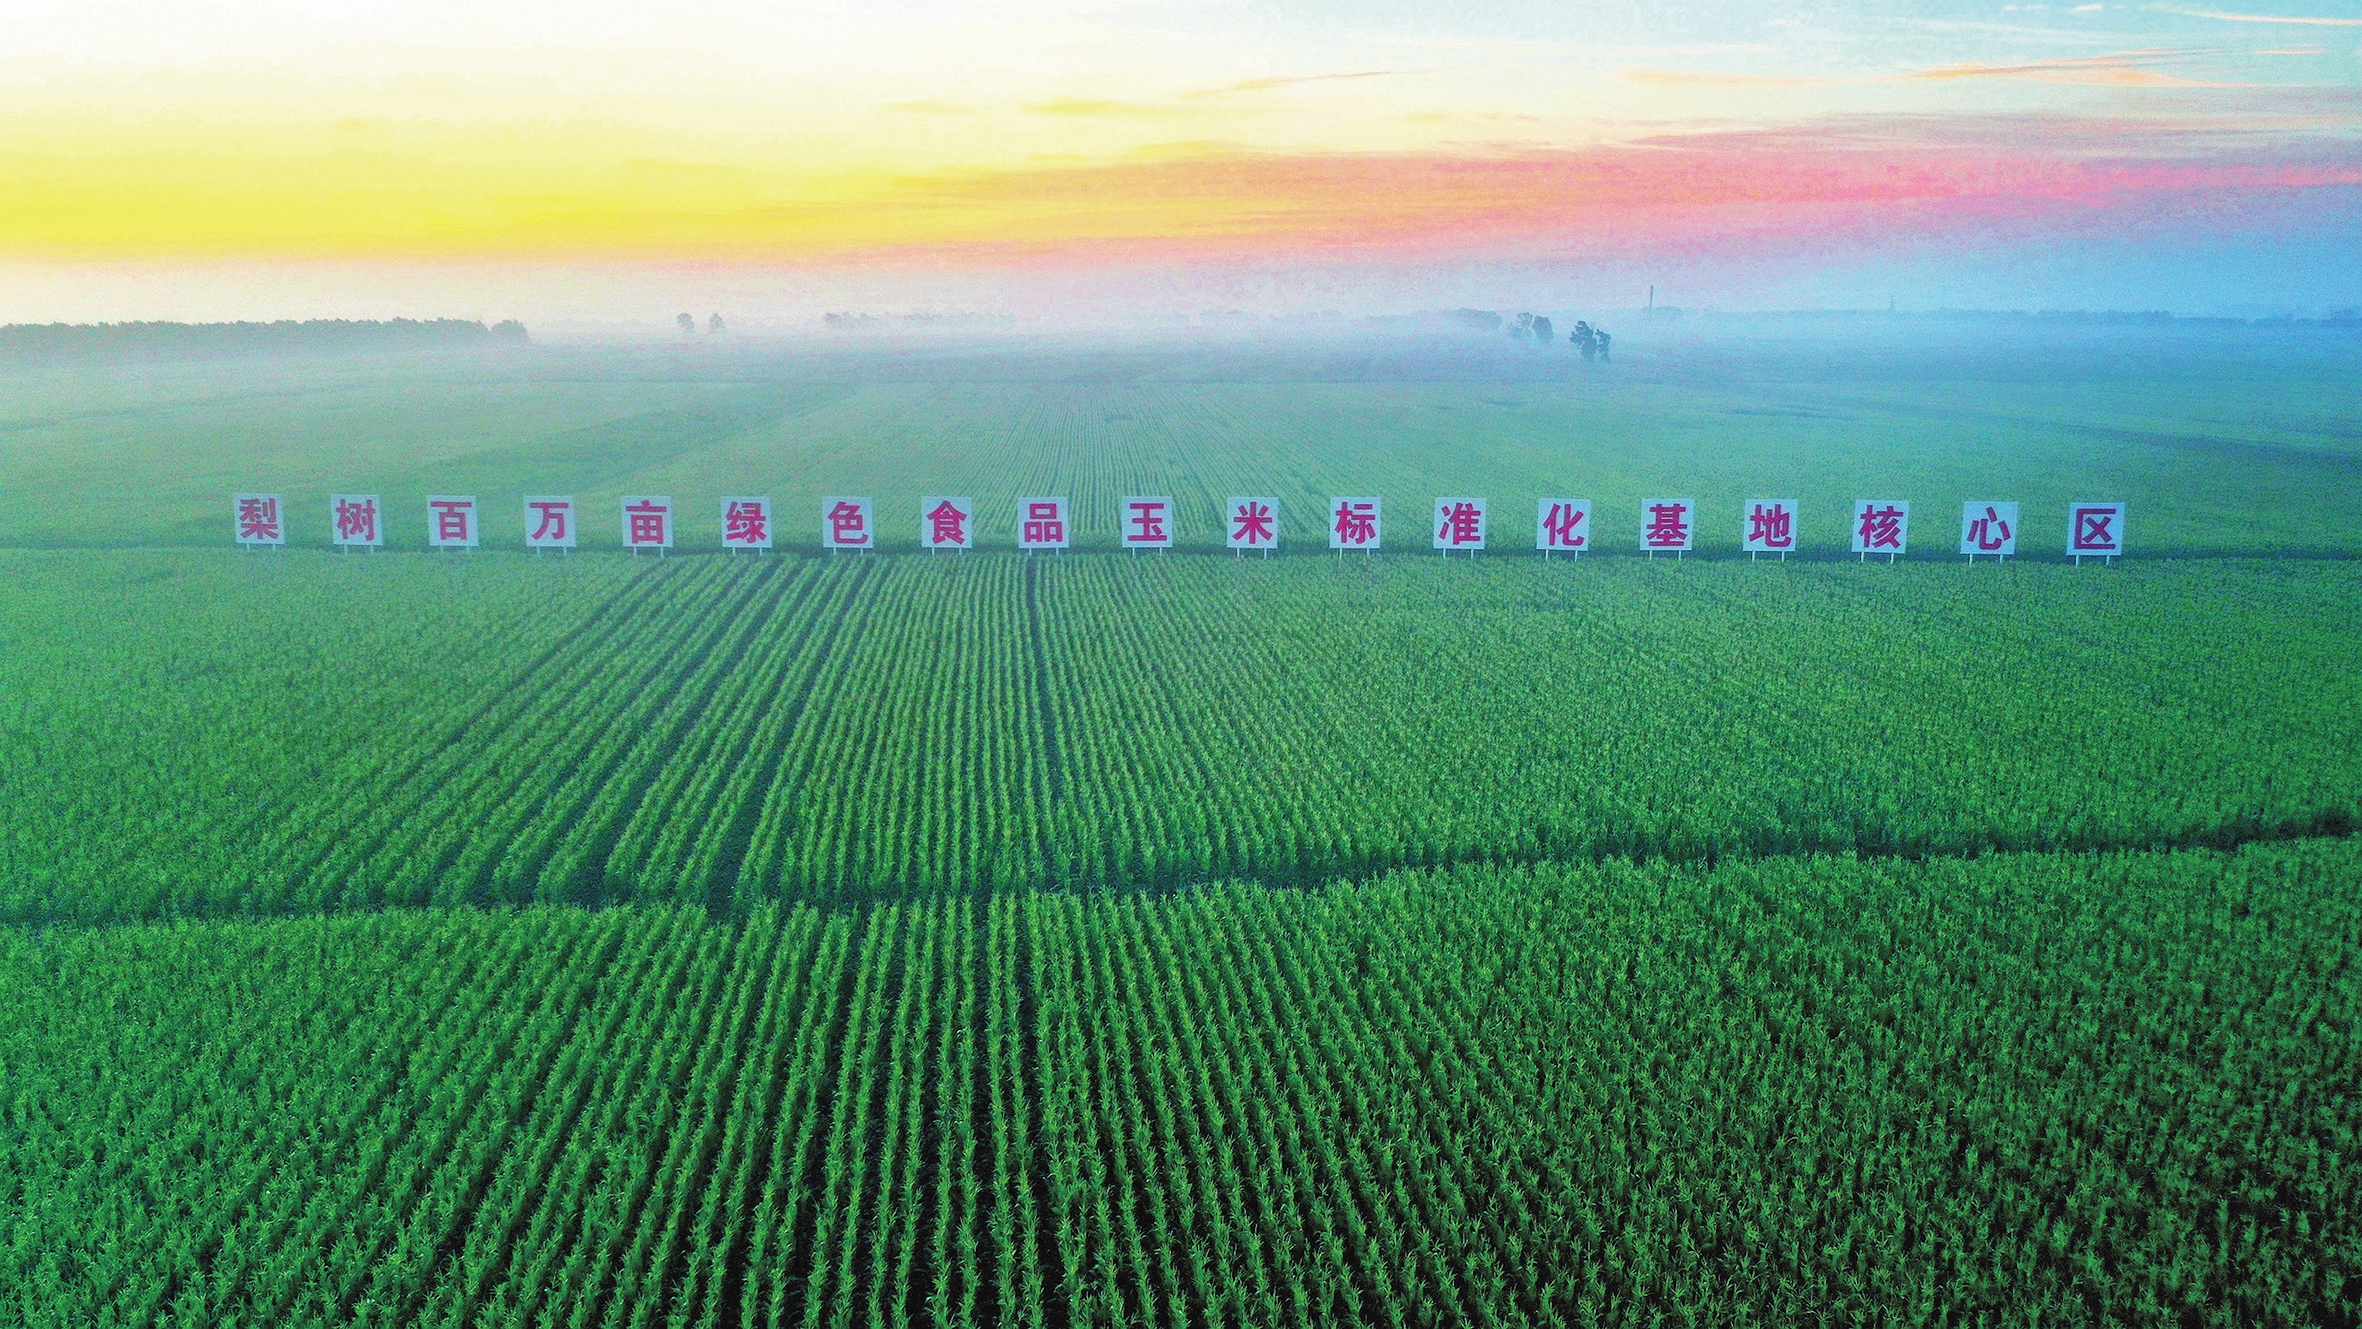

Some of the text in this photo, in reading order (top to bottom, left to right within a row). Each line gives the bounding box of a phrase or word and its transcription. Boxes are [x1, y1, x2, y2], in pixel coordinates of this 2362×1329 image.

[239, 498, 2116, 550] 梨树百万亩绿色食品玉米标准化基地核心区
